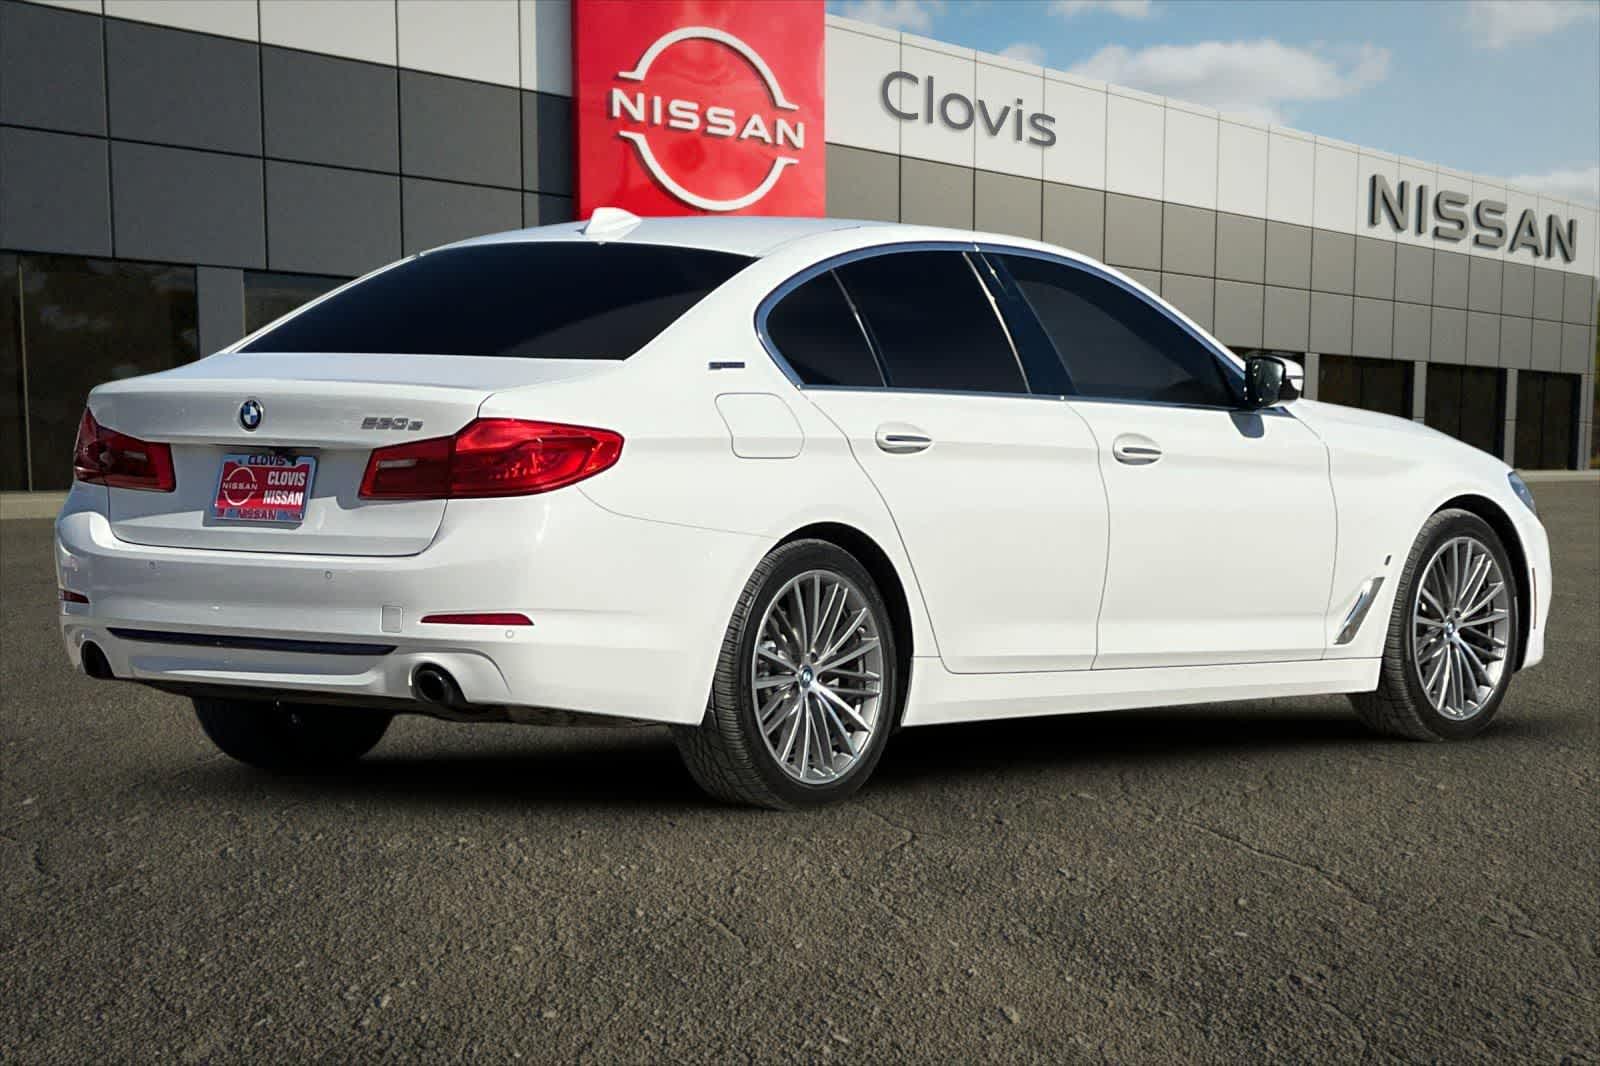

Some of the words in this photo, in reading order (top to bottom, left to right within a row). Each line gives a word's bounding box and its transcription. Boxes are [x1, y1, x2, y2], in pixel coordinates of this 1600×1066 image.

[611, 88, 804, 149] NISSAN
[881, 71, 1057, 147] Clovis
[1368, 173, 1578, 263] NISSAN
[223, 482, 258, 490] NISSAN
[263, 490, 304, 506] NISSAN
[267, 471, 306, 487] CLOVIS
